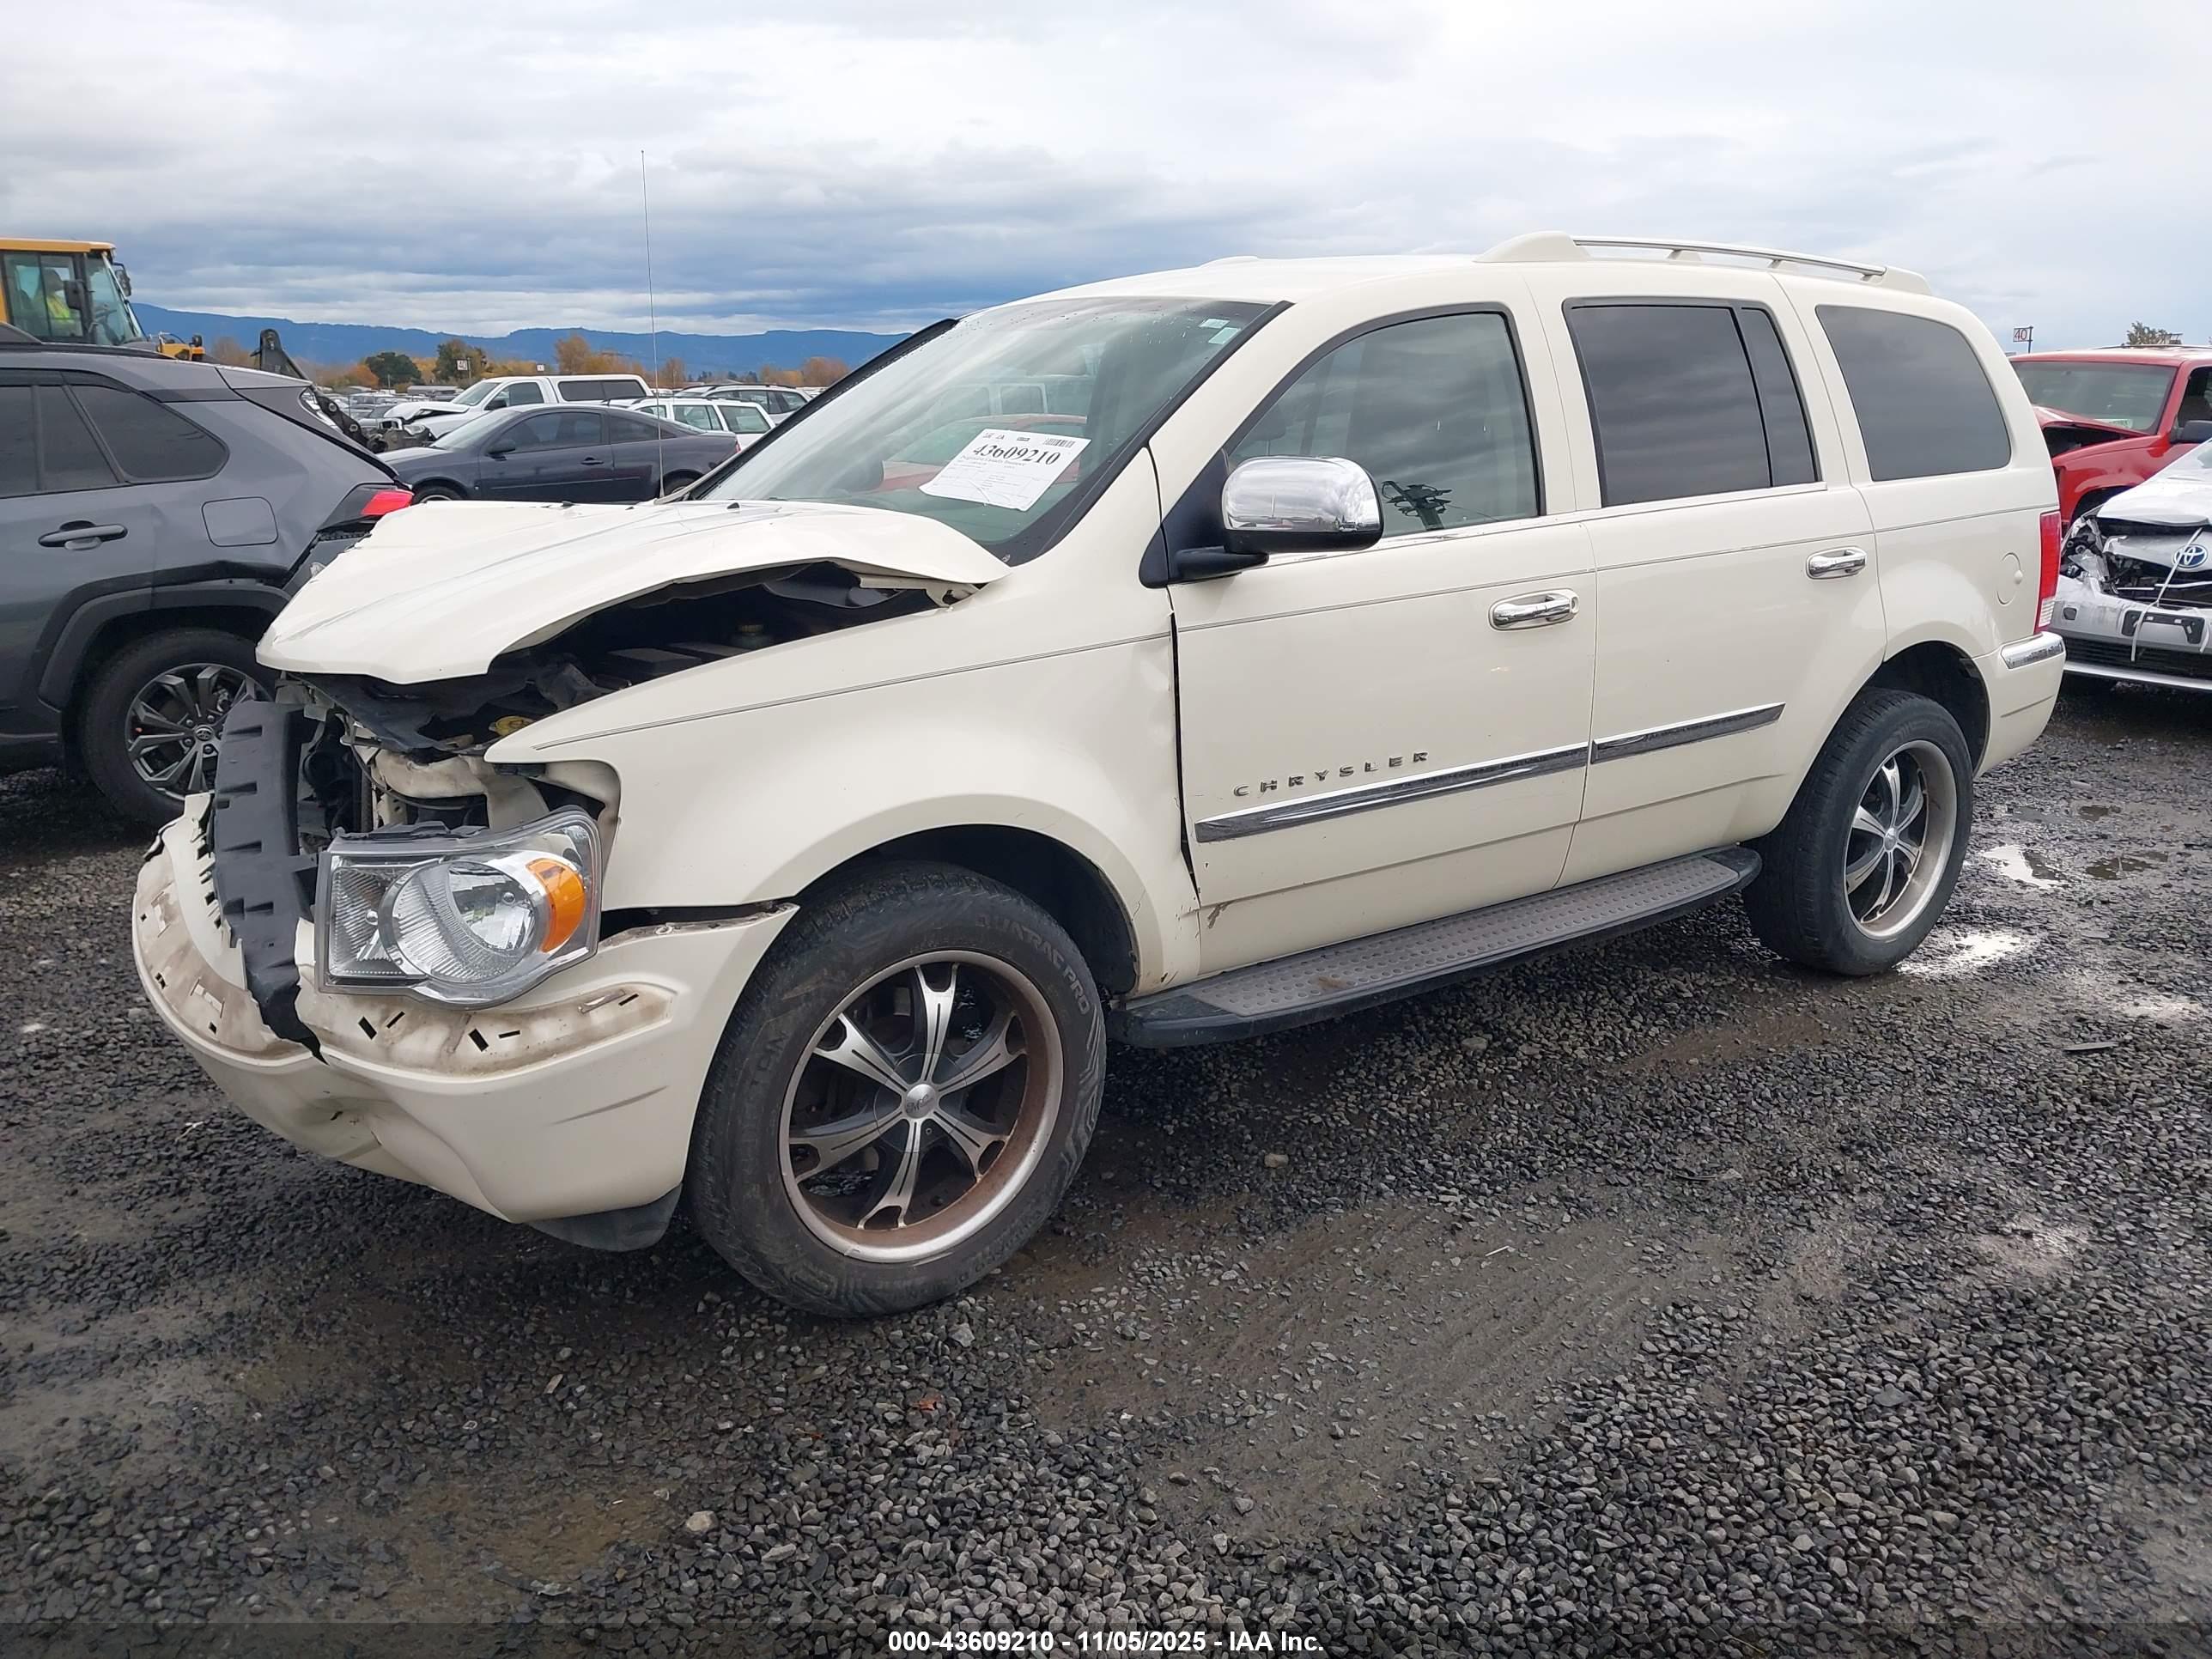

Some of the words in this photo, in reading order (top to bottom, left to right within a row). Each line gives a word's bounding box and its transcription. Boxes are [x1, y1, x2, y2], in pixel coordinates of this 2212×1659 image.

[2014, 327, 2027, 341] 40
[973, 443, 1061, 465] 43609210
[1233, 751, 1428, 797] CHRYSLER
[1063, 963, 1091, 1016] PRO
